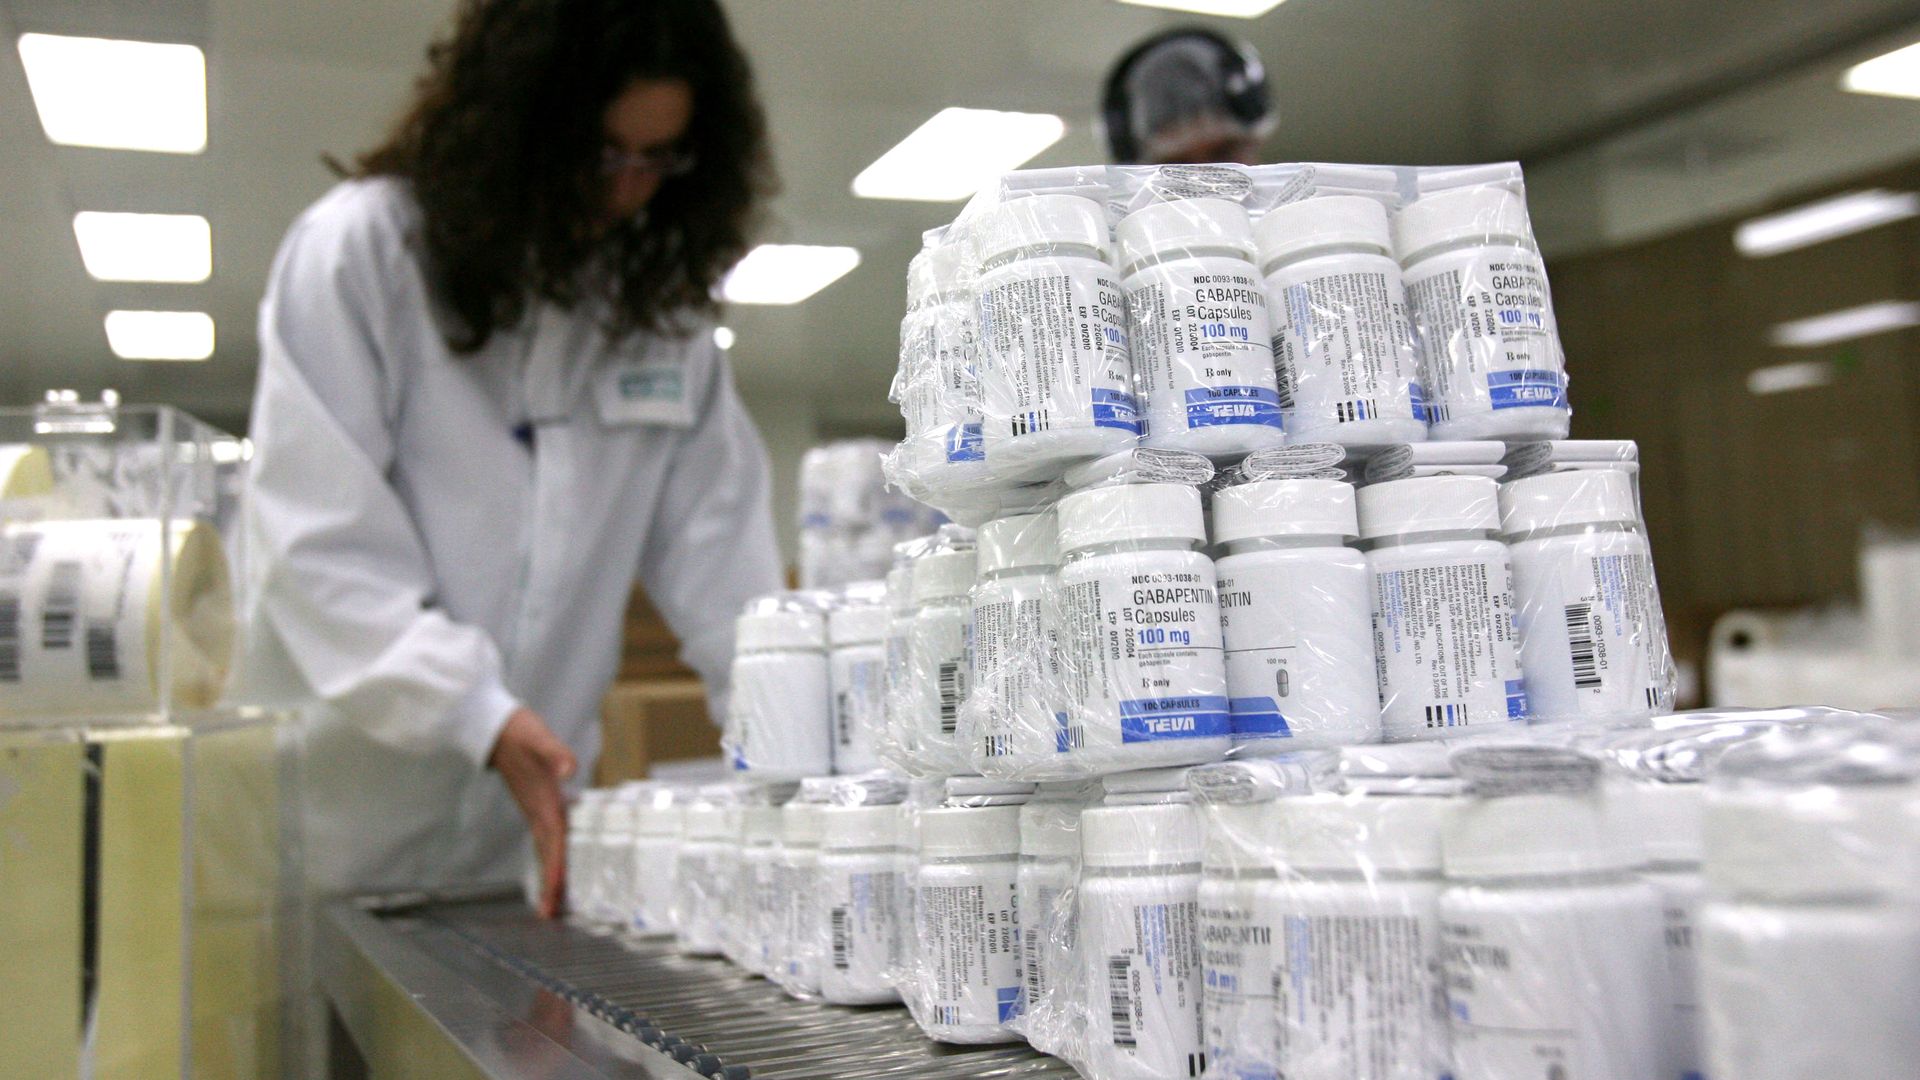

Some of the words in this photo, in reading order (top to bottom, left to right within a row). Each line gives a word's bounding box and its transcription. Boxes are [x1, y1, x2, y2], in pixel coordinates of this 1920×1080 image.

[1194, 275, 1211, 284] NDC
[1079, 306, 1087, 319] EXP
[1092, 305, 1100, 318] LOT
[1172, 309, 1181, 321] EXP
[1186, 305, 1196, 318] LOT
[1198, 306, 1252, 321] Capsules
[1499, 310, 1521, 324] 100
[1081, 324, 1090, 351] 01/2010
[1103, 327, 1120, 344] 100
[1200, 324, 1226, 338] 100
[1230, 326, 1248, 341] mg
[1216, 368, 1232, 377] only
[1208, 389, 1221, 398] 100
[1512, 387, 1553, 401] TEVA
[1212, 404, 1256, 418] TEVA
[1132, 575, 1150, 584] NDC
[1414, 569, 1422, 607] Manufactured
[1134, 588, 1213, 606] GABAPENTIN
[1123, 607, 1133, 622] LOT
[1135, 608, 1196, 626] Capsules
[1409, 586, 1418, 638] PHARMACEUTICAL
[1495, 614, 1503, 642] 01/2010
[1137, 628, 1165, 645] 100
[1170, 630, 1190, 646] mg
[1435, 624, 1445, 664] MEDICATIONS
[1593, 615, 1608, 670] 0093-1038-01
[1153, 679, 1170, 688] only
[1144, 702, 1158, 711] 100
[1160, 699, 1200, 710] CAPSULES
[1144, 716, 1195, 734] TEVA
